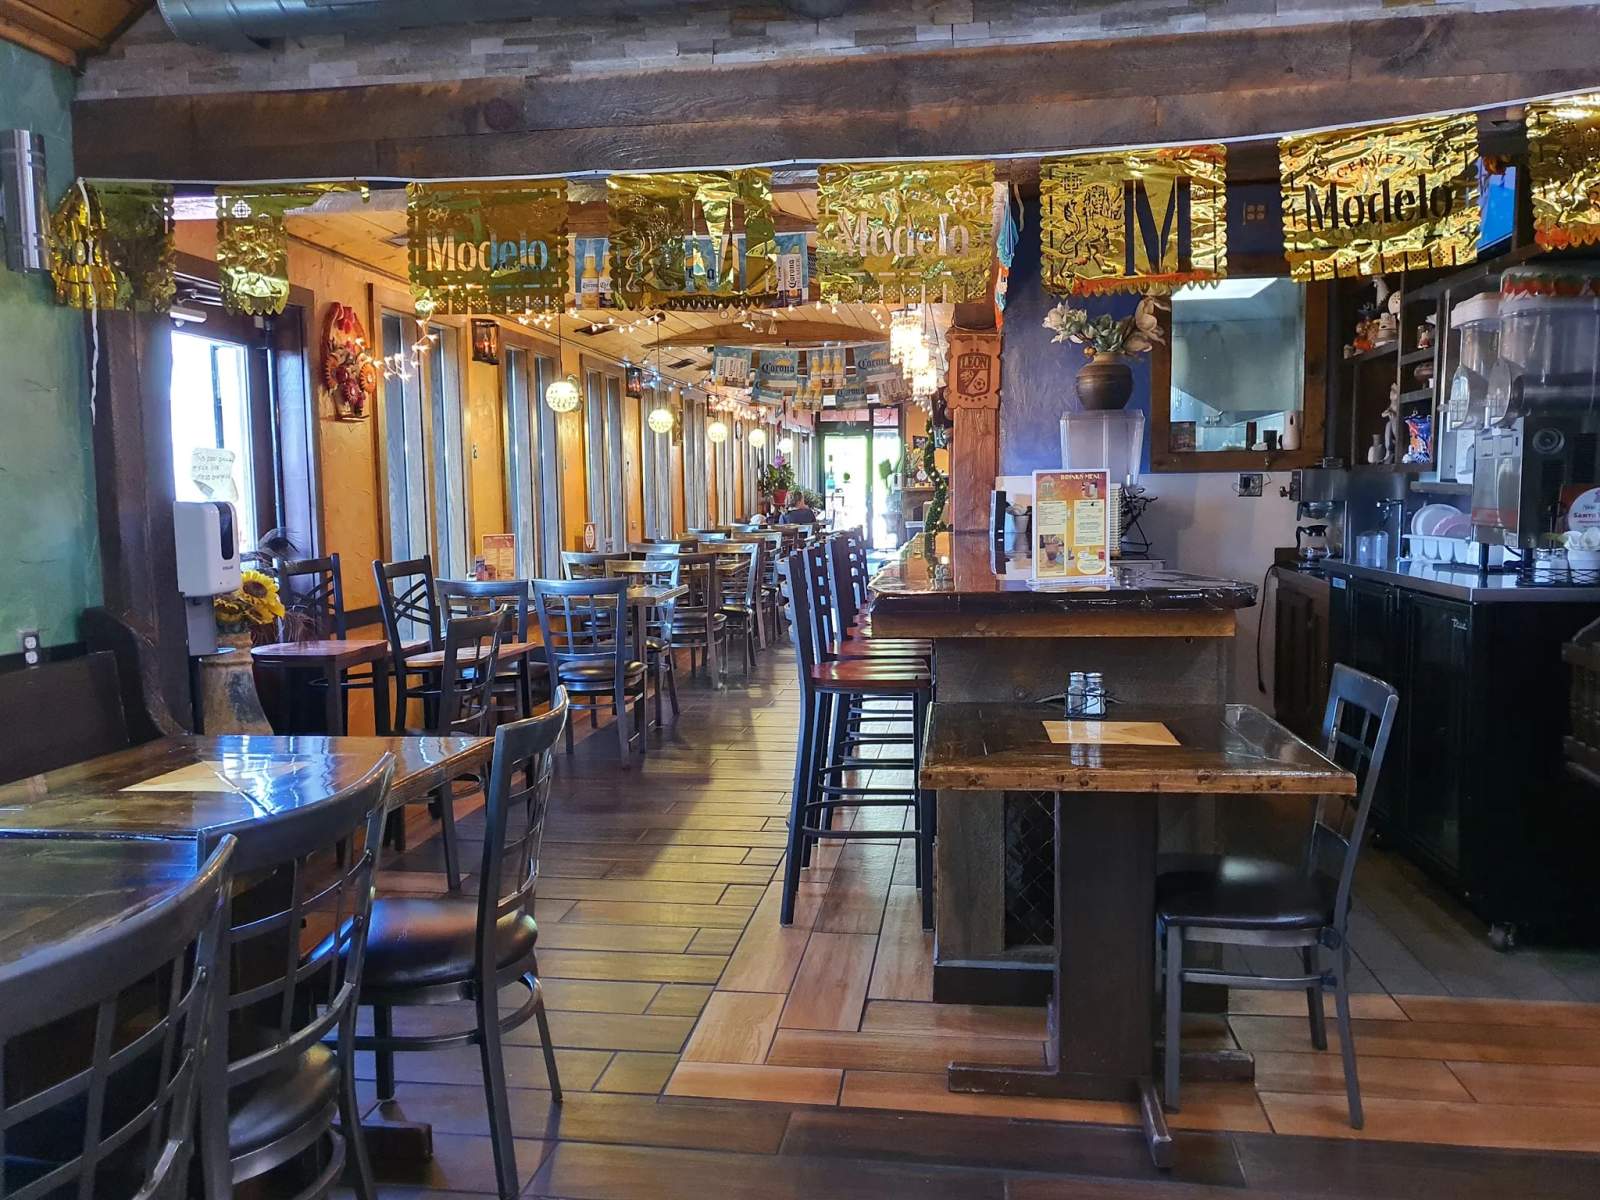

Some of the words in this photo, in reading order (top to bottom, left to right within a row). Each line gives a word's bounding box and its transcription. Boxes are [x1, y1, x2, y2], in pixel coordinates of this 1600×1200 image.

[1304, 173, 1454, 232] Modelo
[837, 211, 970, 257] Modelo
[1122, 175, 1193, 277] M
[426, 228, 549, 272] Modelo
[761, 360, 795, 375] Corona
